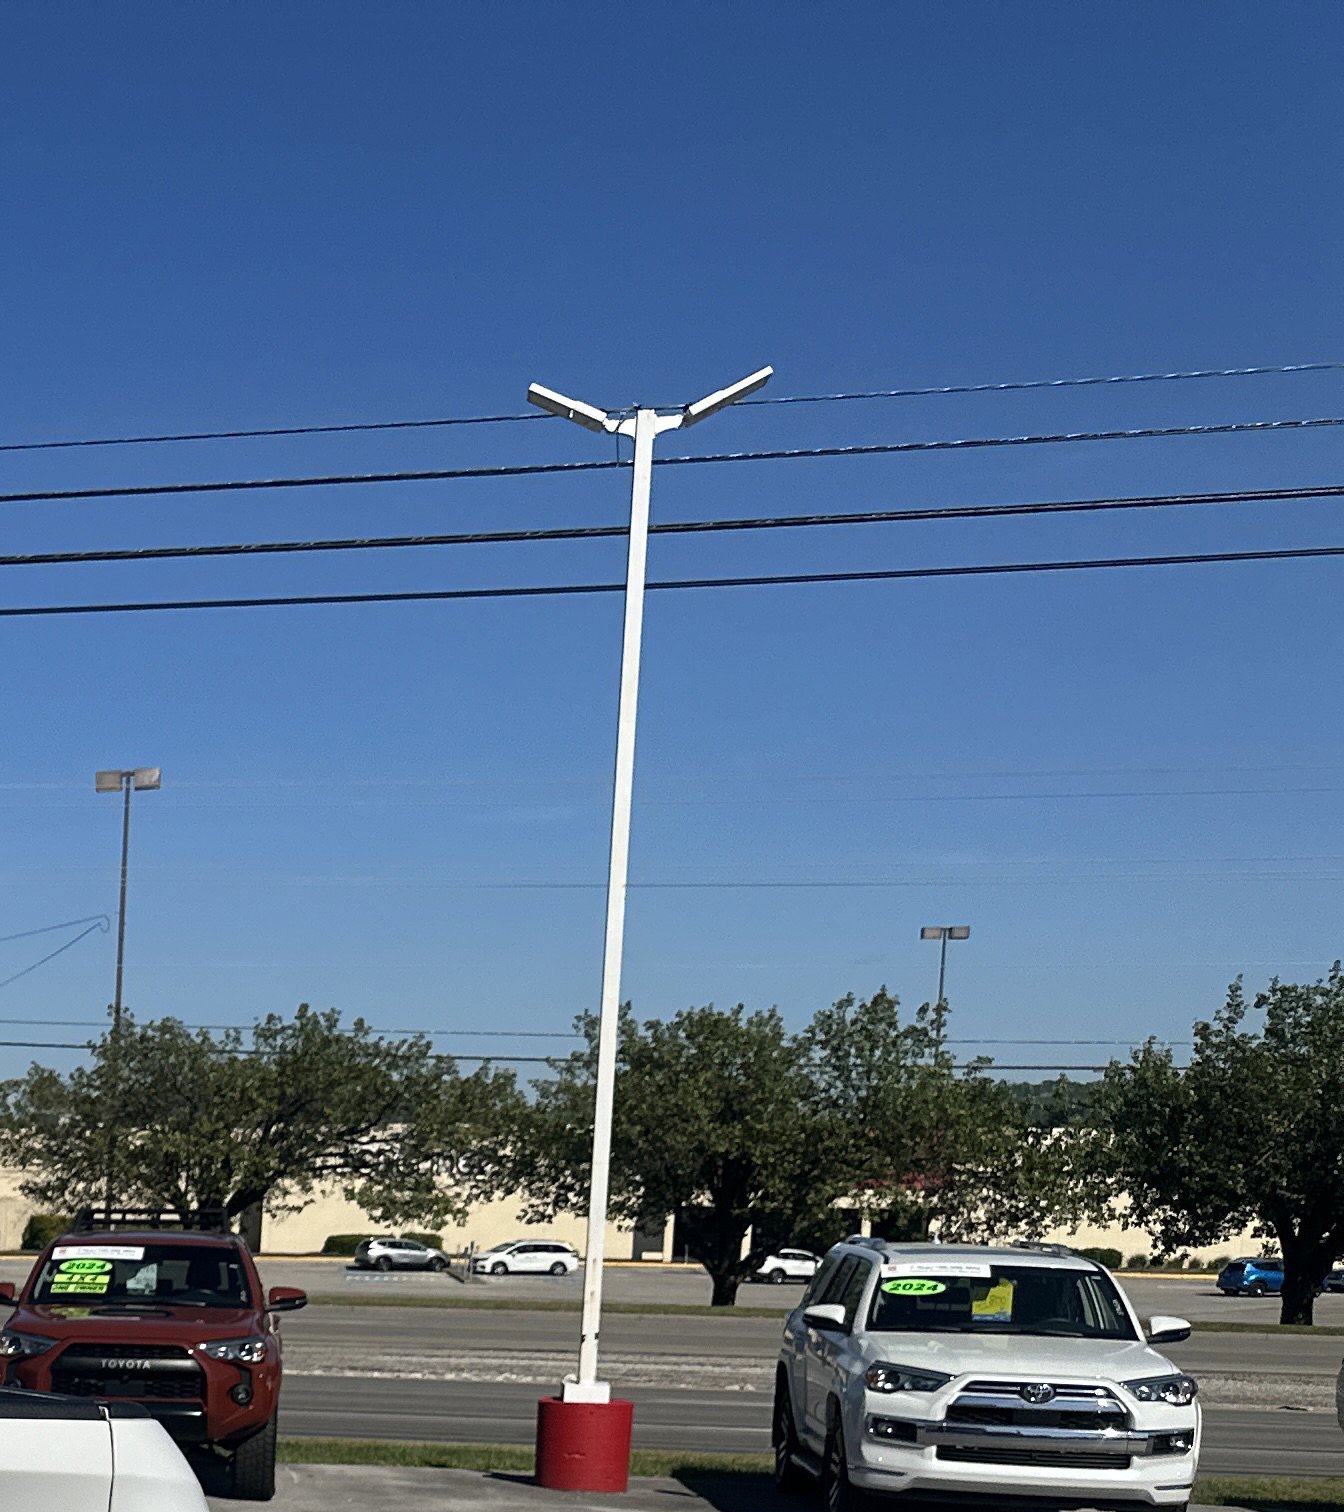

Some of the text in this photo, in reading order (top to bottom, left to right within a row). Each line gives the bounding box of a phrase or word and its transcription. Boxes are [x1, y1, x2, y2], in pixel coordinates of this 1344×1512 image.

[66, 1262, 108, 1270] 2024
[888, 1283, 939, 1292] 2024
[100, 1358, 151, 1369] TOYOTA
